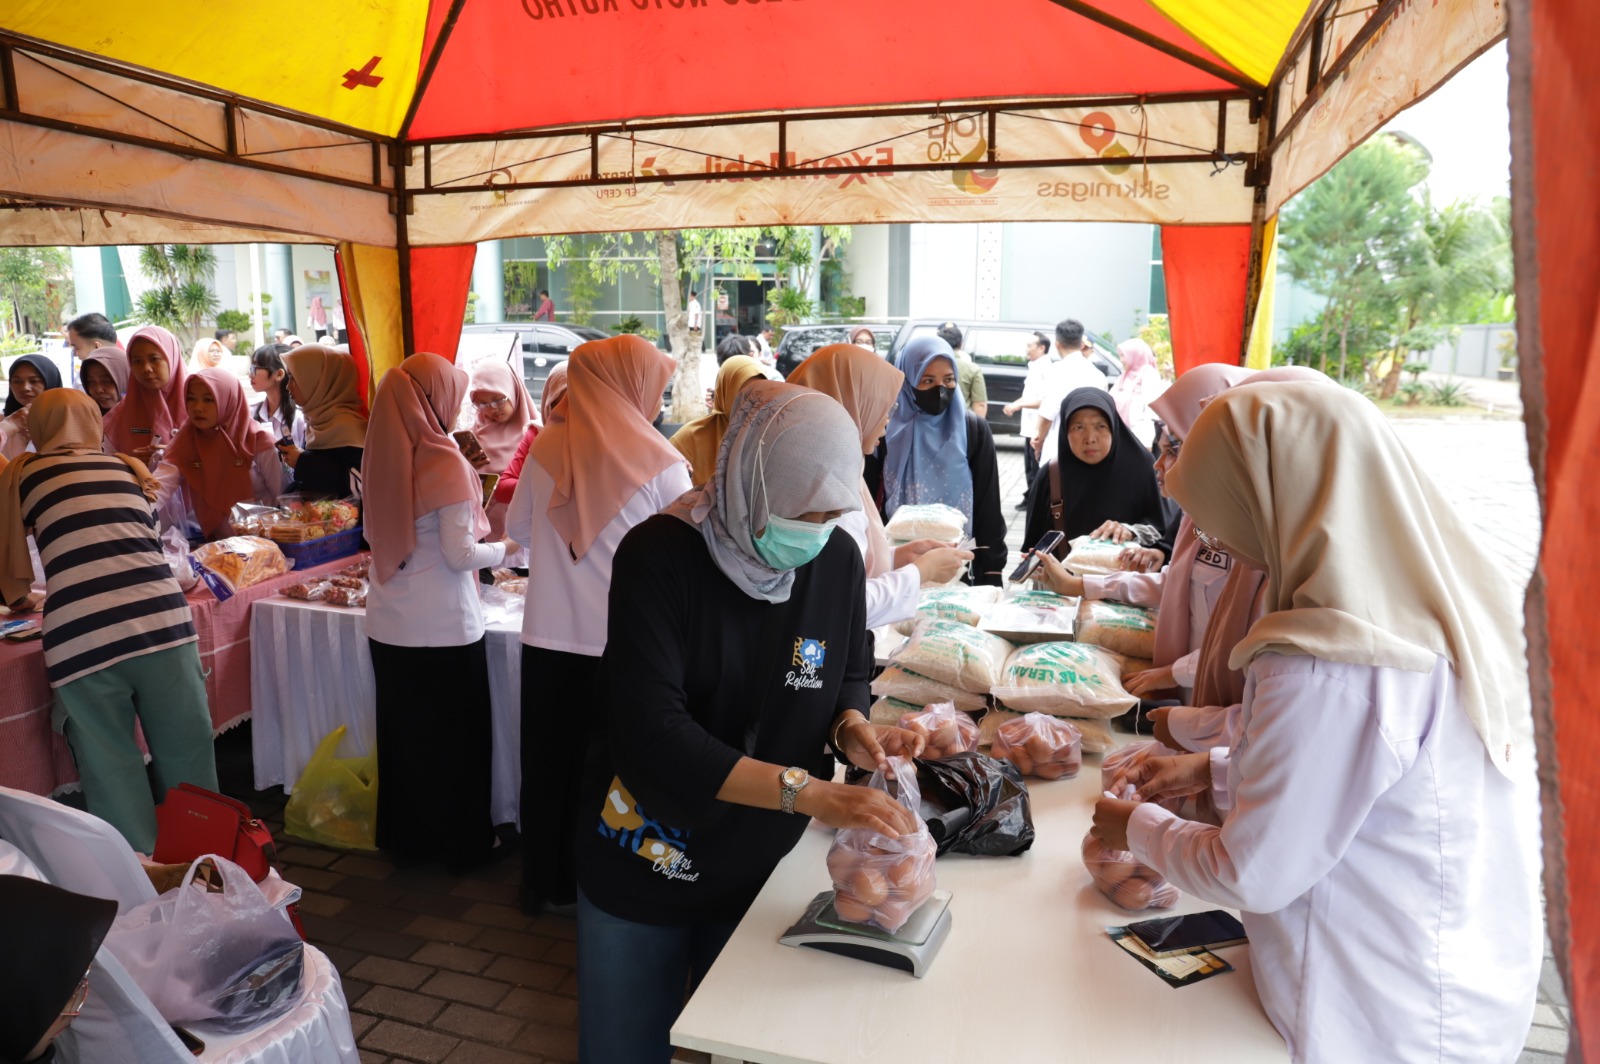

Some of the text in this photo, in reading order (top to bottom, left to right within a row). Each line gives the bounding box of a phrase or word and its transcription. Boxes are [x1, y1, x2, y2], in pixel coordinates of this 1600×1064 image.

[801, 659, 816, 678] Self
[785, 671, 823, 690] Reflection
[653, 857, 699, 882] Original
